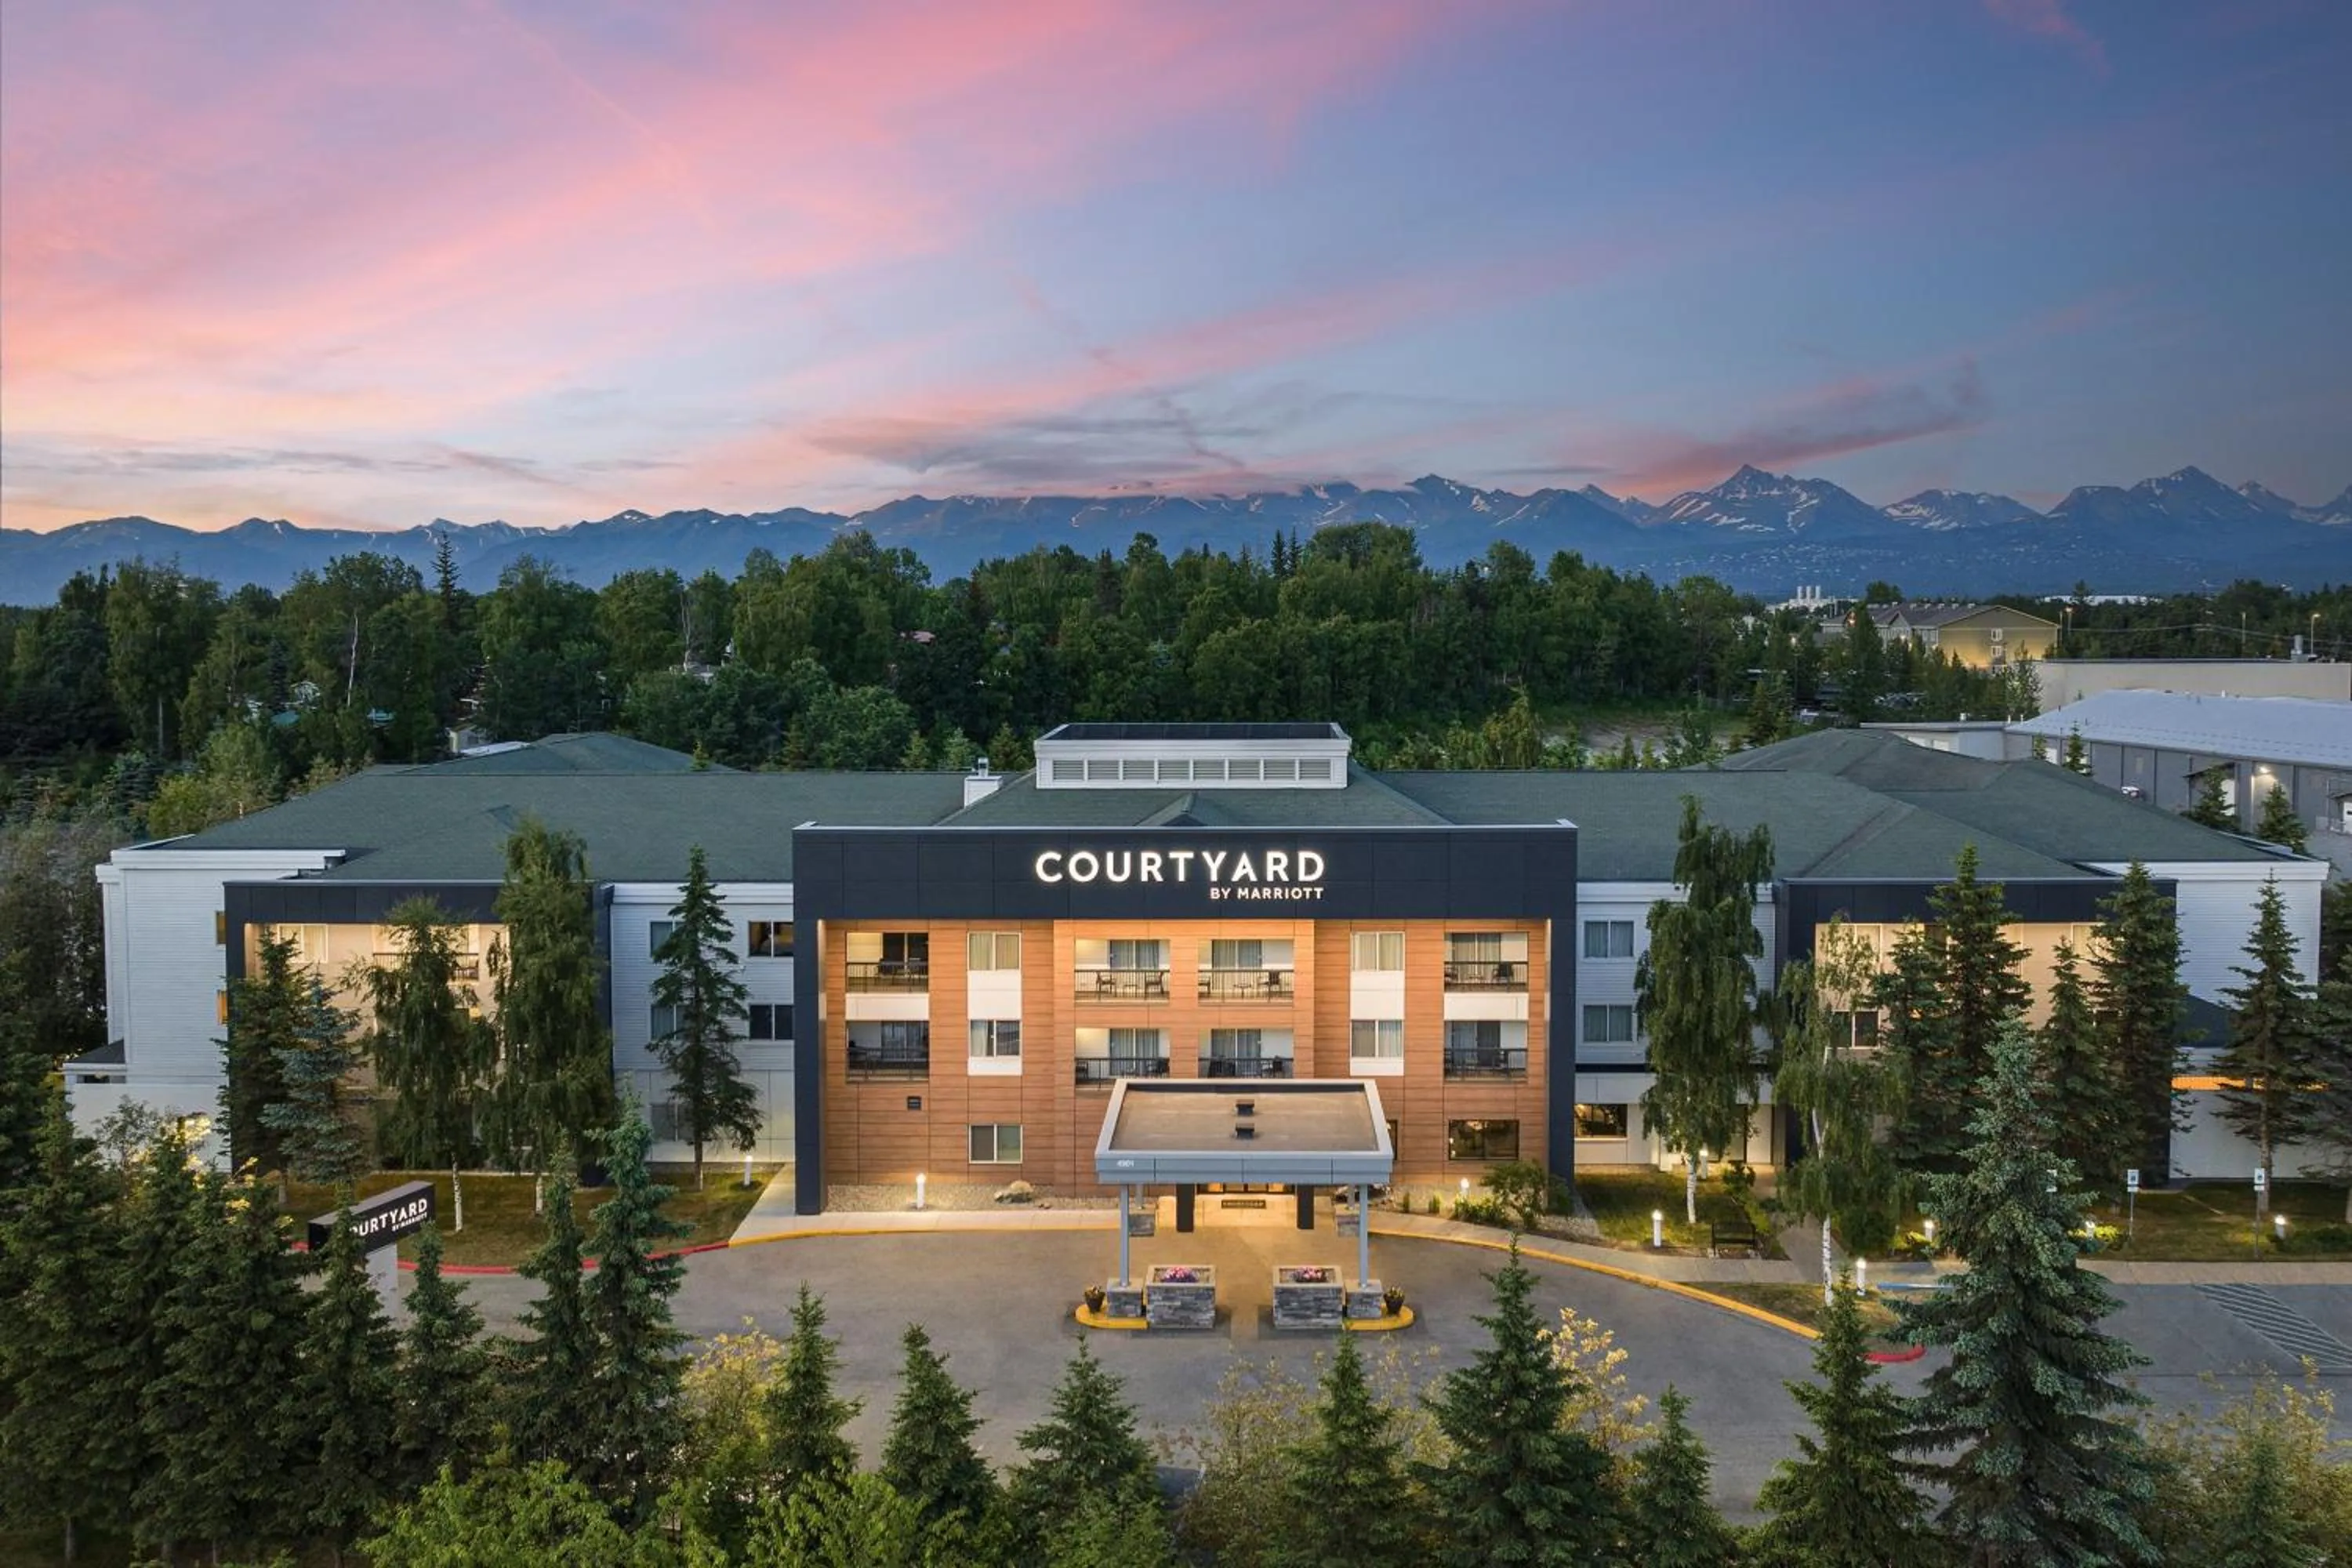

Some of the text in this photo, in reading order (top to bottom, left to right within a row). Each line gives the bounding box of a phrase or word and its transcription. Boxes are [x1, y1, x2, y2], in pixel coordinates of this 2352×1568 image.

[1035, 851, 1325, 882] COURTYARD
[1210, 887, 1324, 899] BY MARRIOTT
[349, 1199, 427, 1236] URTYARD
